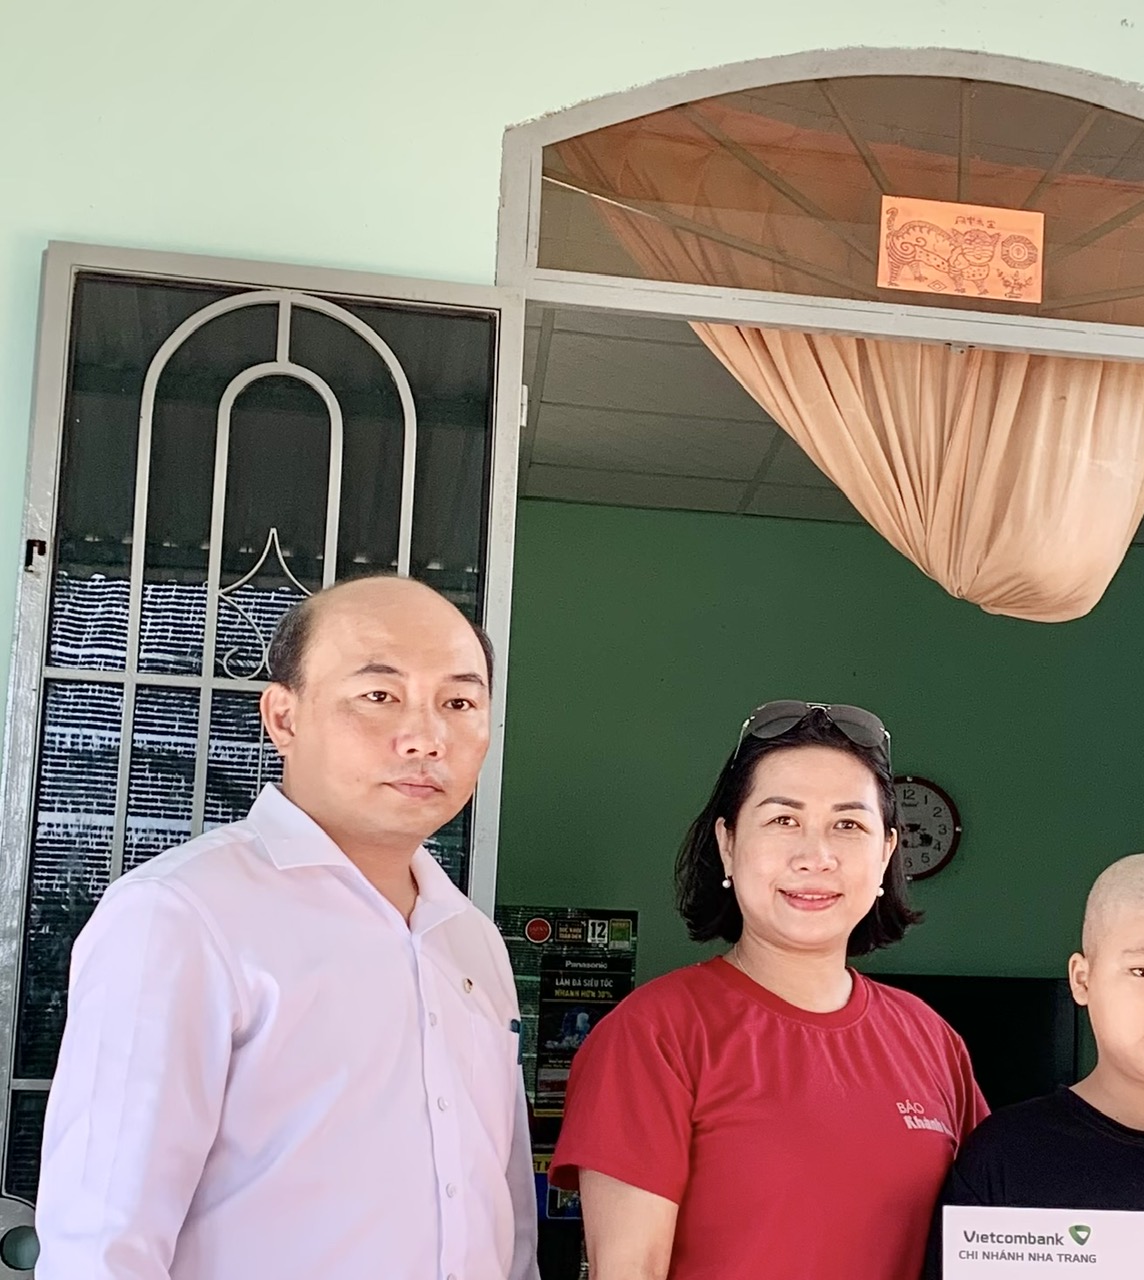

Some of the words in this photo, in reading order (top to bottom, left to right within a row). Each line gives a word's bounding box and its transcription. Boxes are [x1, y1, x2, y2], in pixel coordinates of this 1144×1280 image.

[903, 789, 915, 800] 12
[924, 794, 928, 805] 1
[933, 807, 942, 817] 2
[938, 824, 947, 835] 3
[933, 842, 941, 852] 4
[921, 853, 930, 863] 5
[590, 922, 606, 939] 12
[565, 960, 608, 969] Panasonic
[896, 1099, 925, 1114] BÁO
[963, 1229, 1065, 1246] Vietcombank
[958, 1250, 978, 1260] CHI
[982, 1249, 1024, 1261] NHÁNH
[1028, 1252, 1054, 1262] NHA
[1056, 1253, 1097, 1264] TRANG
